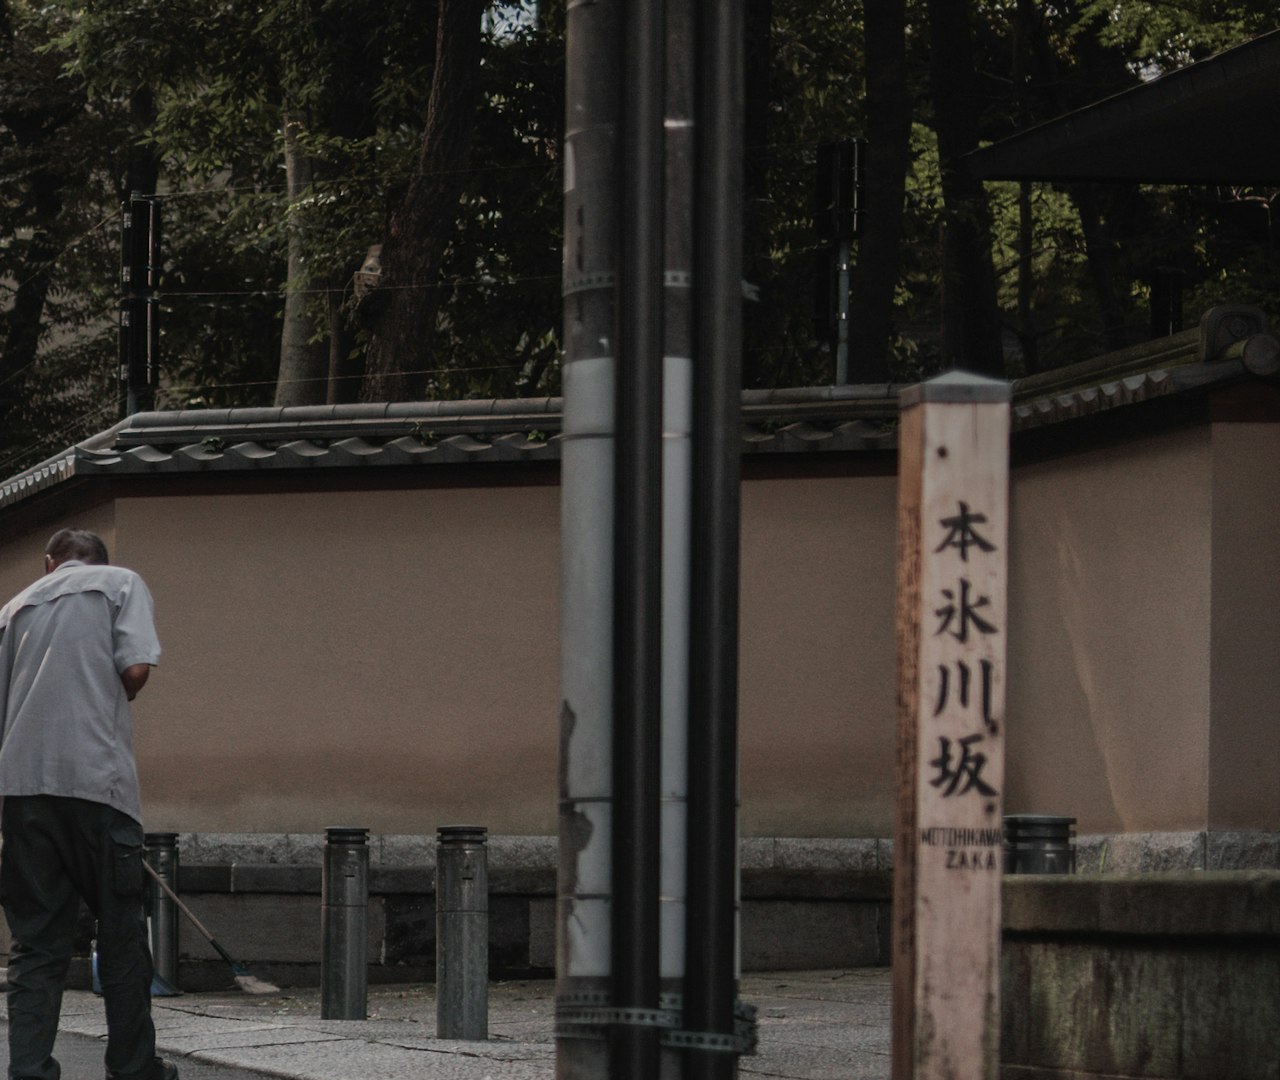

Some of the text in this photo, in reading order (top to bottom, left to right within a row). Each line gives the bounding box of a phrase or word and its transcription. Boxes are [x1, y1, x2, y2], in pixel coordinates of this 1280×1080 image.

[928, 499, 999, 798] 本氷川坂
[945, 850, 997, 870] ZAKA
